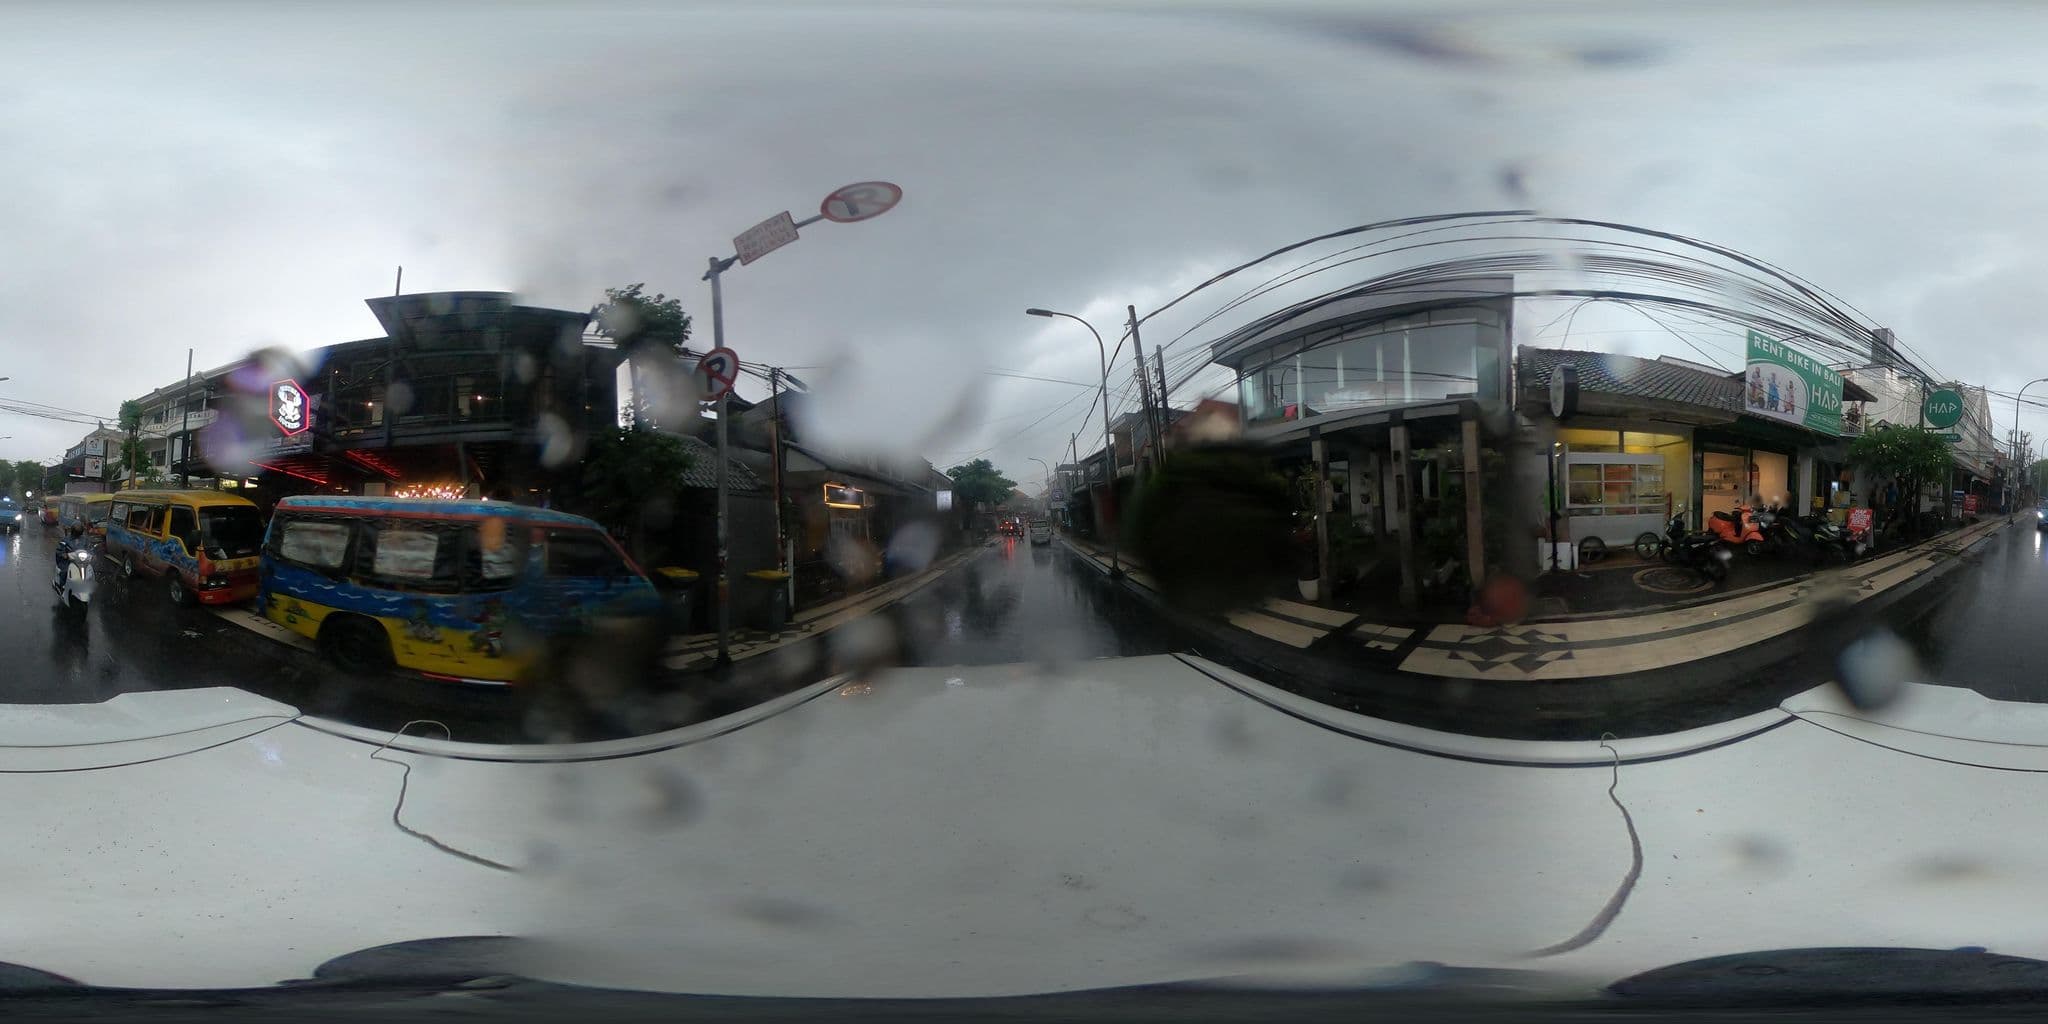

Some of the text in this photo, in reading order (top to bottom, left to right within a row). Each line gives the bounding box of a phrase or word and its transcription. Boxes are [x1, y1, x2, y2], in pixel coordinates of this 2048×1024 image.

[706, 357, 726, 392] P
[1753, 335, 1841, 386] RENT BIKE IN BALI
[1812, 383, 1839, 411] HAP
[1929, 402, 1957, 414] HAP
